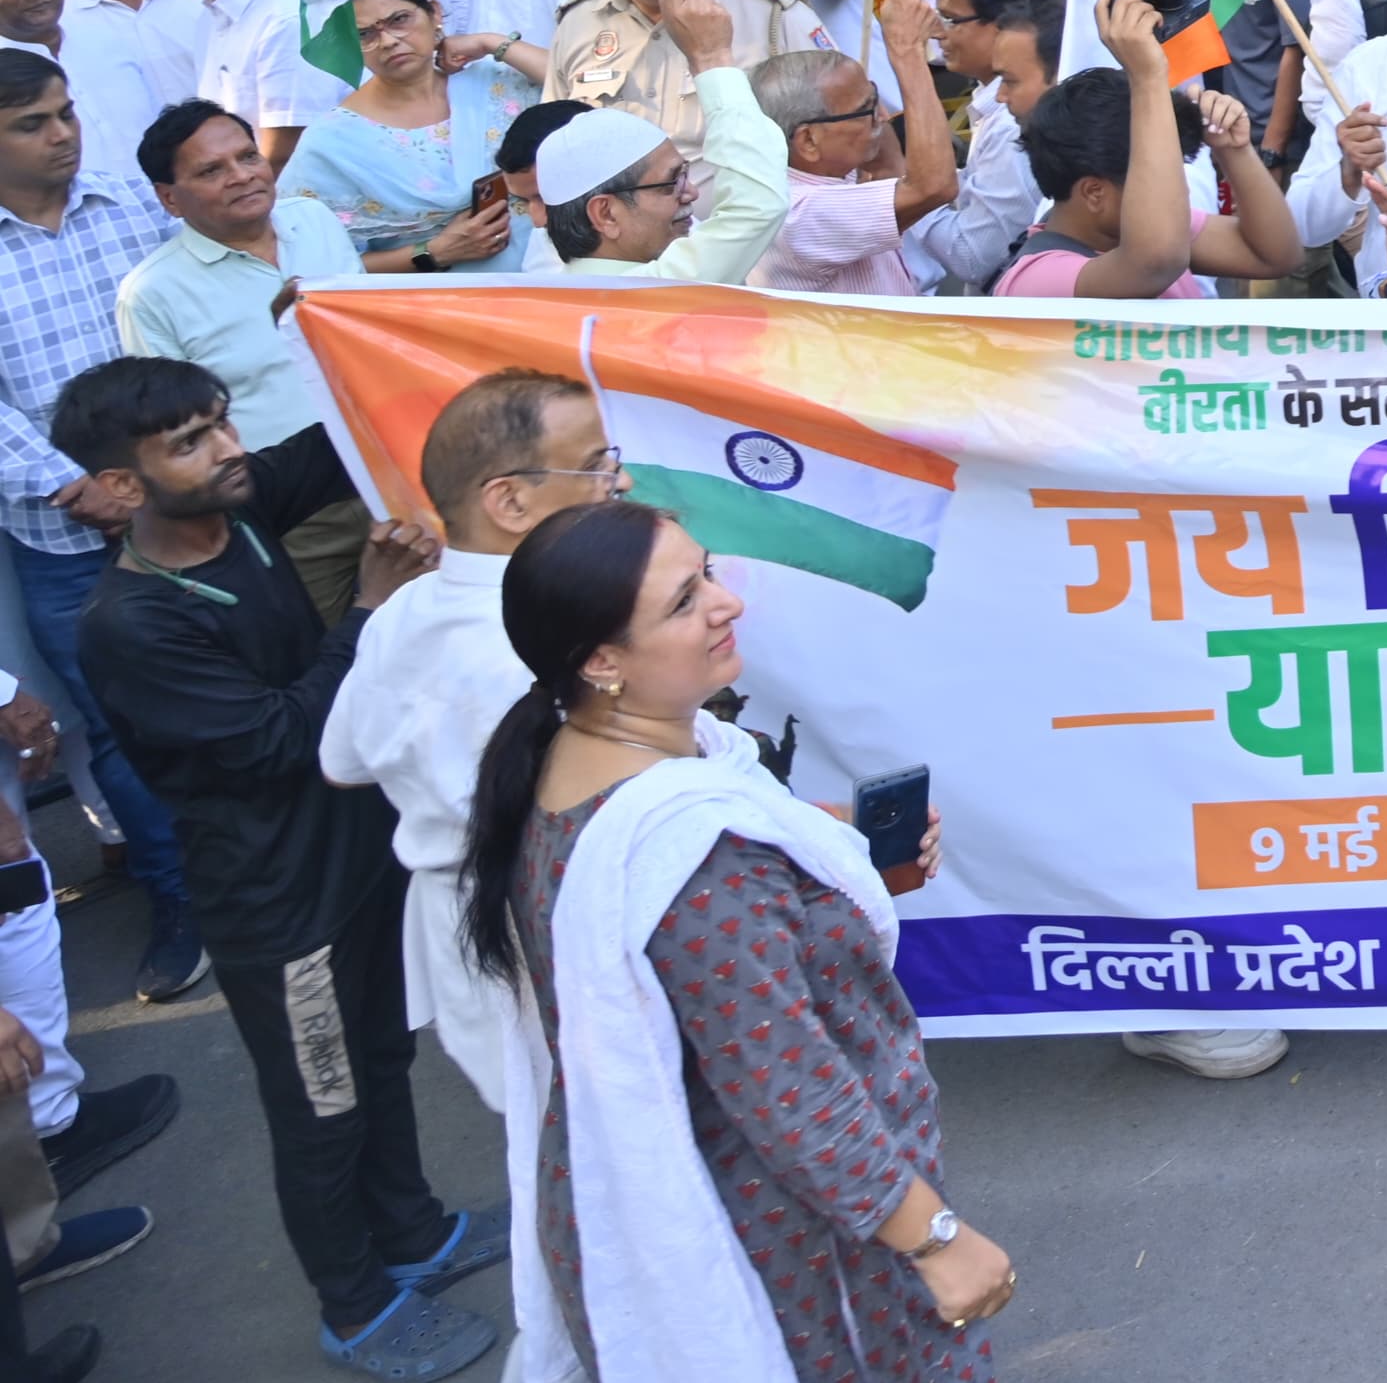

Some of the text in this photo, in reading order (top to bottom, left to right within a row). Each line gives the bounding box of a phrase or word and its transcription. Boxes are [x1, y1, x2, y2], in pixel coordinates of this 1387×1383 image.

[1138, 368, 1270, 434] वीरता
[1277, 364, 1327, 428] के
[1029, 488, 1308, 621] जय
[1250, 827, 1285, 873] 9
[1300, 805, 1379, 872] मई
[1021, 926, 1214, 992] दिल्ली
[1225, 925, 1379, 991] प्रदेश
[301, 1011, 344, 1096] Reebok
